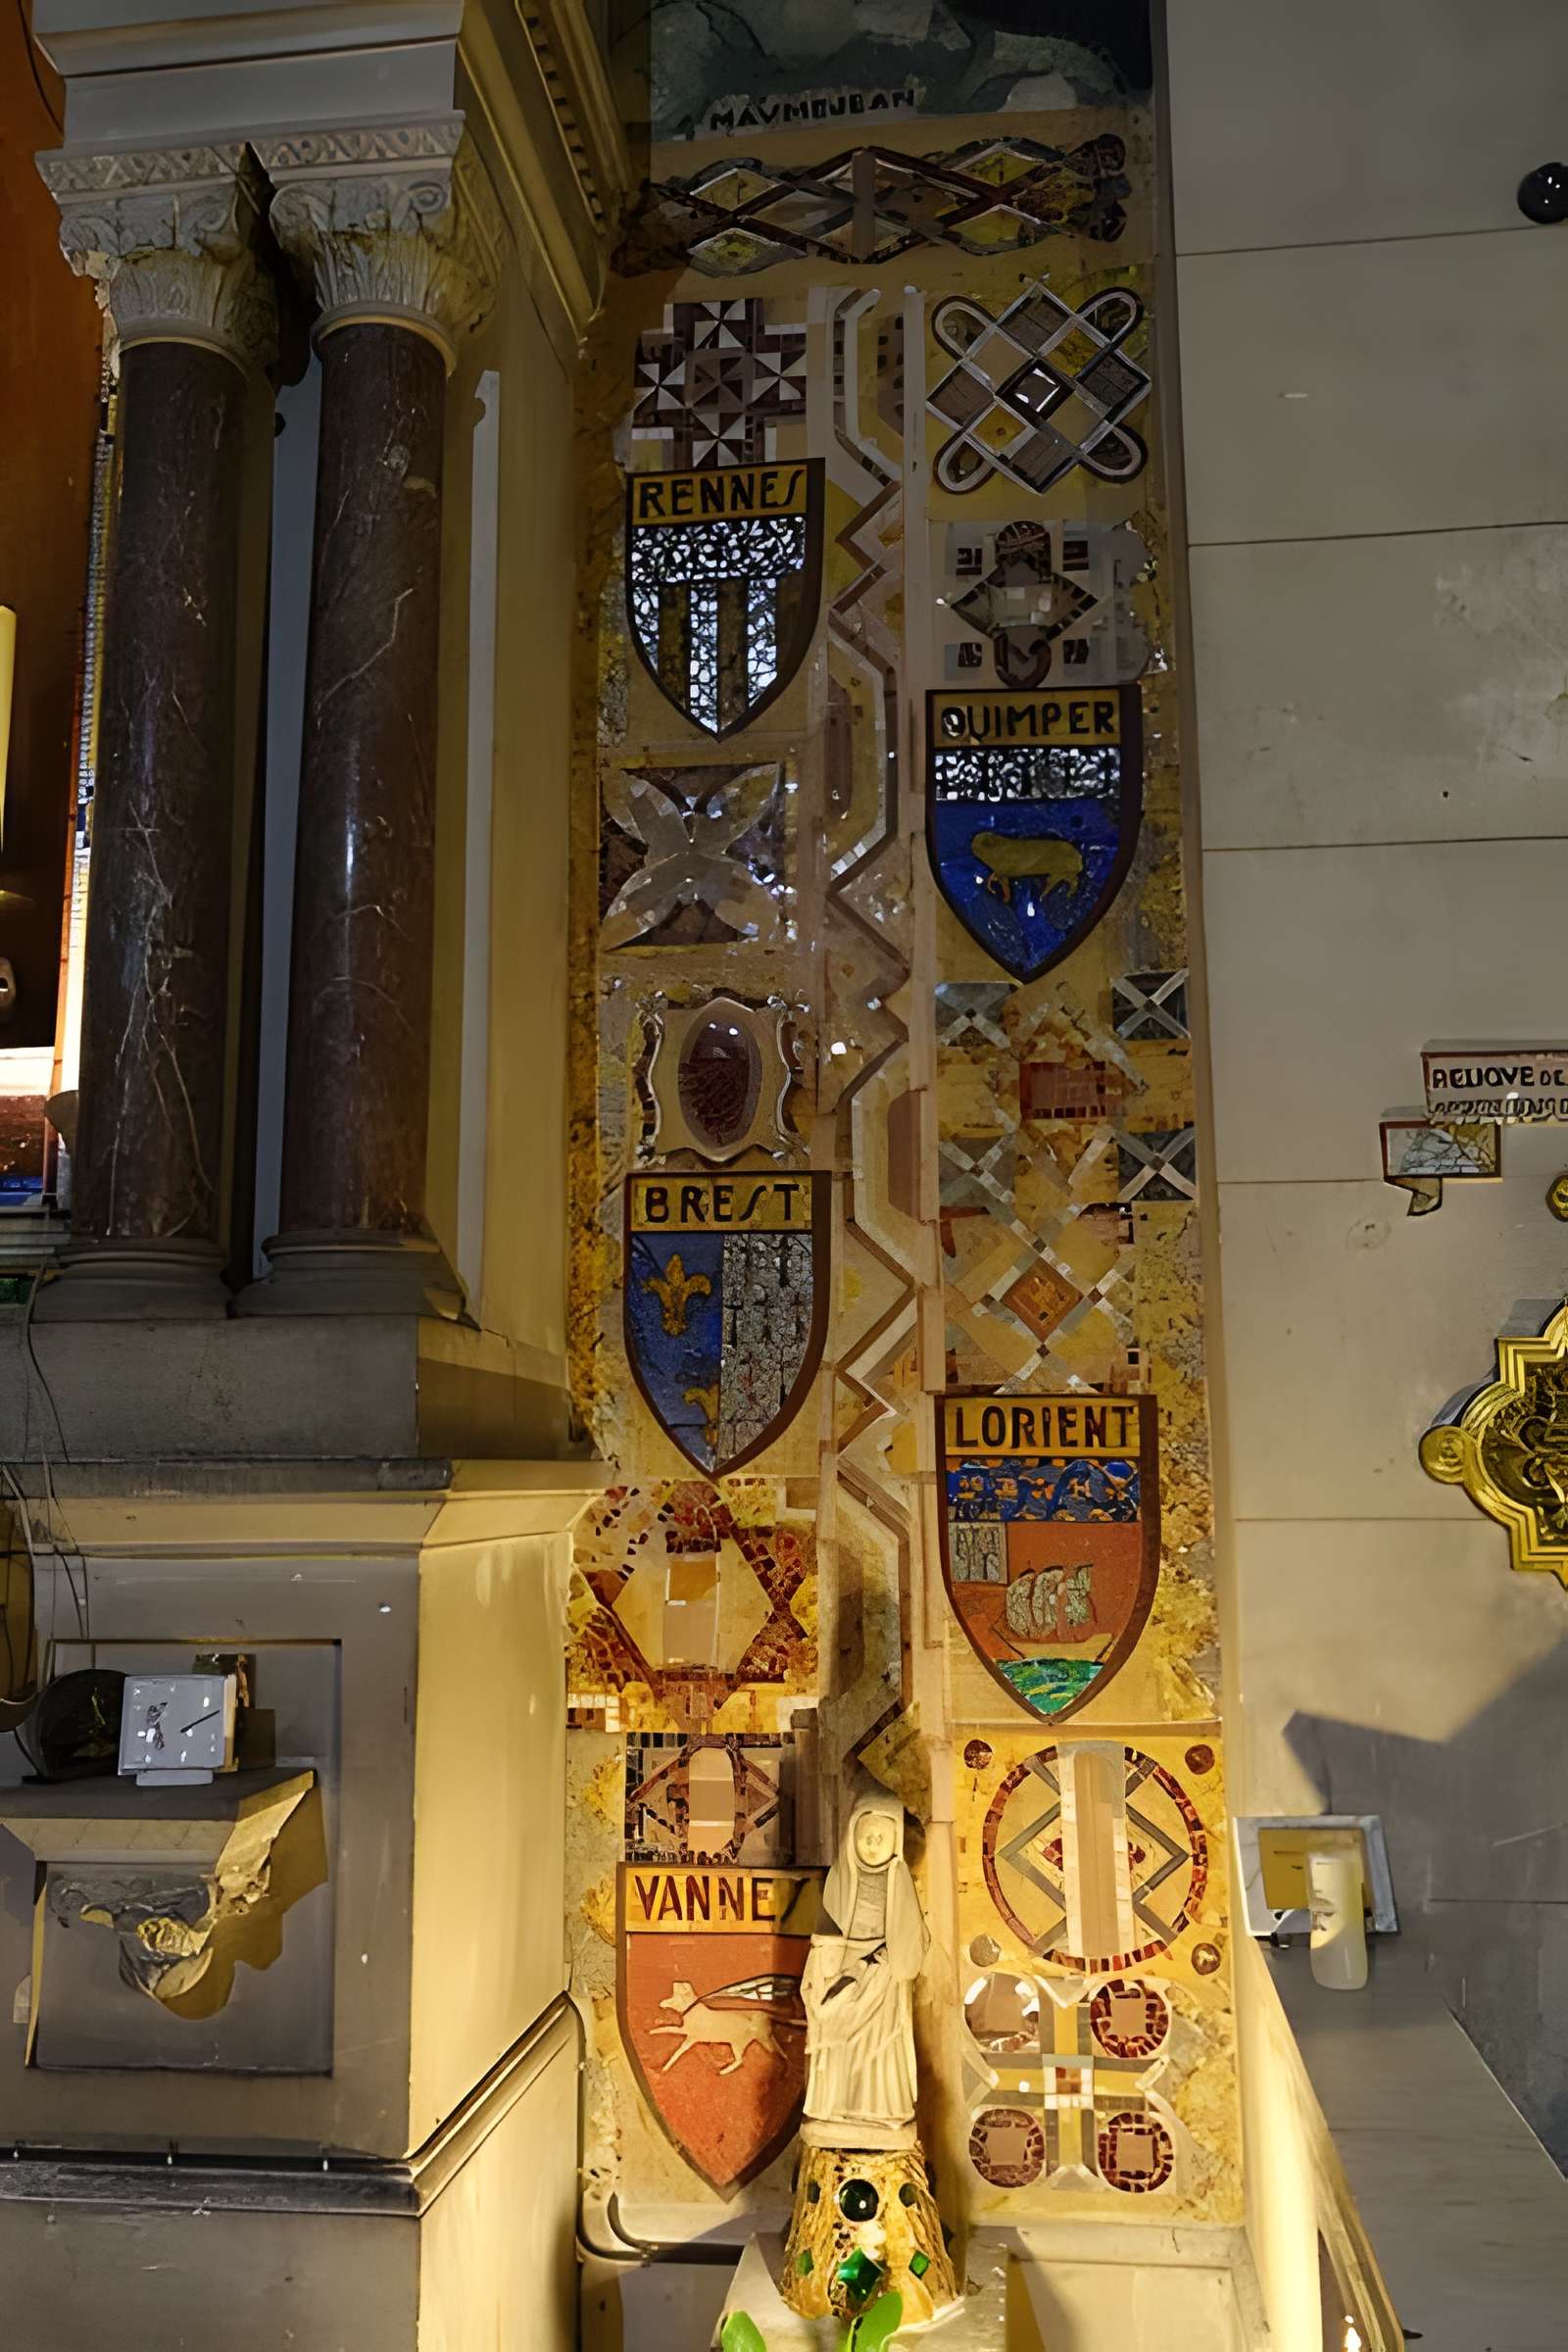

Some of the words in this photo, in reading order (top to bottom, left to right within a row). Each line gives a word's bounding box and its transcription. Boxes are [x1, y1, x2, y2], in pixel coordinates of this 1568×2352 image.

[639, 469, 804, 517] RENNES
[645, 1183, 800, 1223] BREST
[956, 1404, 1133, 1448] LORIENT
[634, 1875, 809, 1922] VANNES
